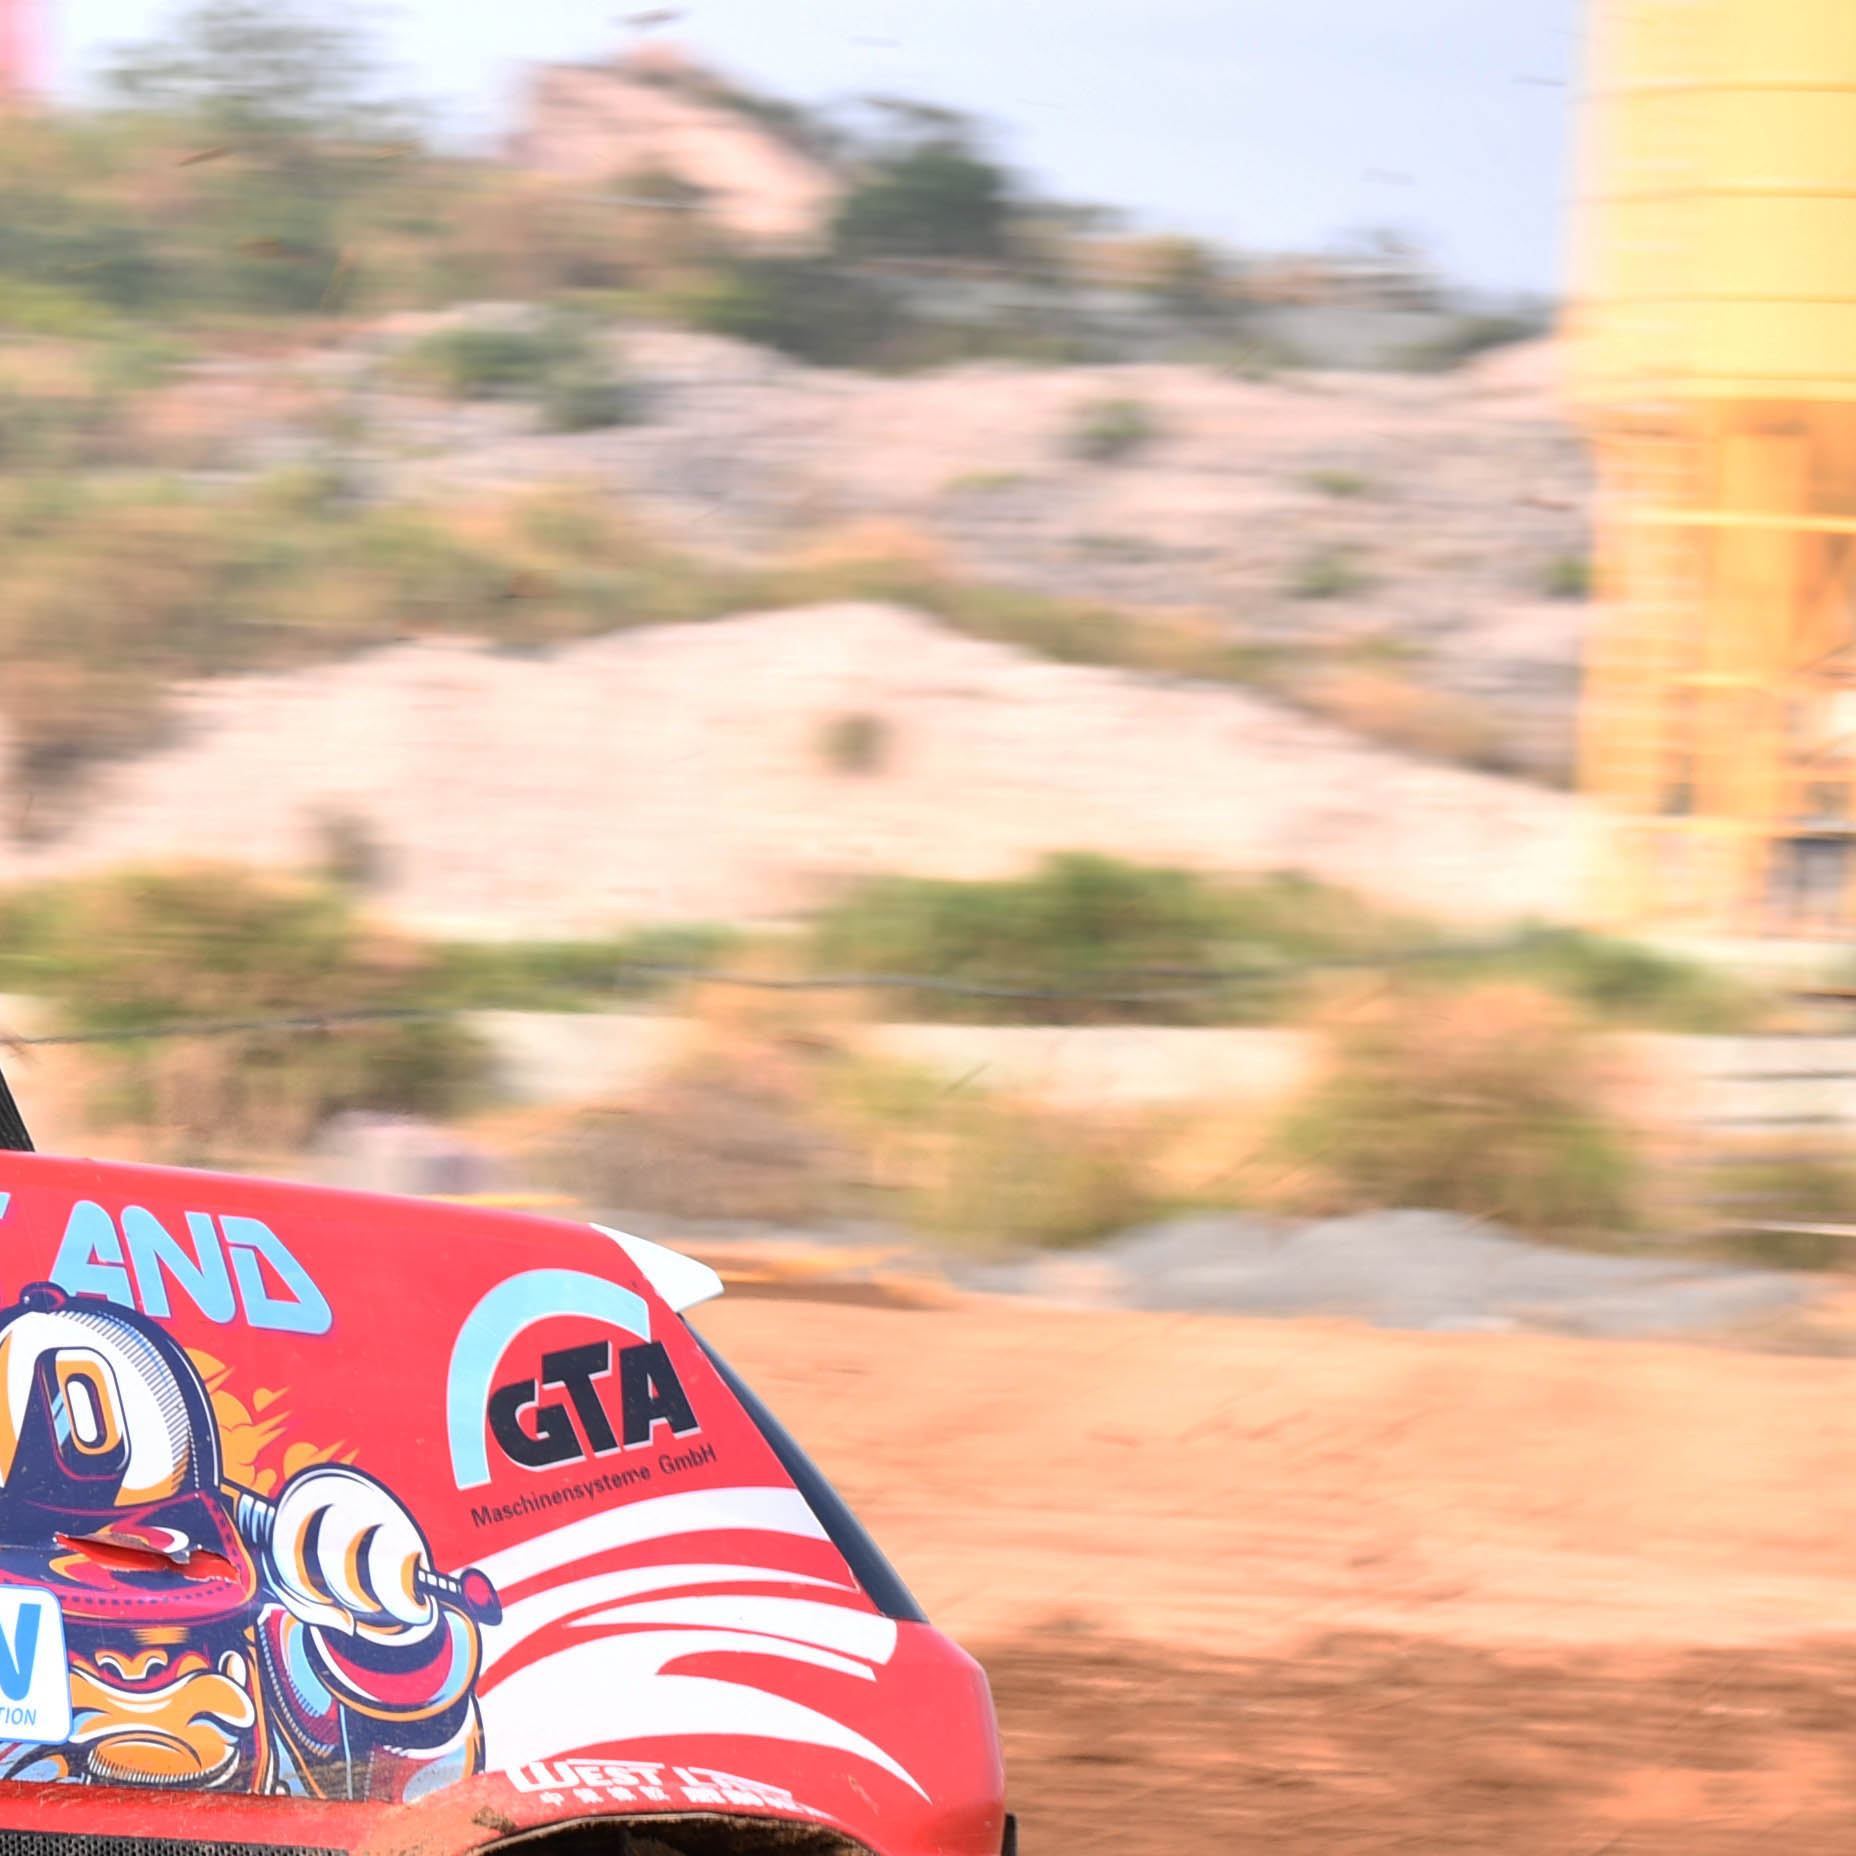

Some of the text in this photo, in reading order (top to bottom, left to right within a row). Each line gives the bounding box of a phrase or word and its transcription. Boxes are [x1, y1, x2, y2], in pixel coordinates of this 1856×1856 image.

[487, 1340, 701, 1472] GTA
[471, 1443, 717, 1528] Maschinensysteme GmbH
[505, 1758, 665, 1793] WEST
